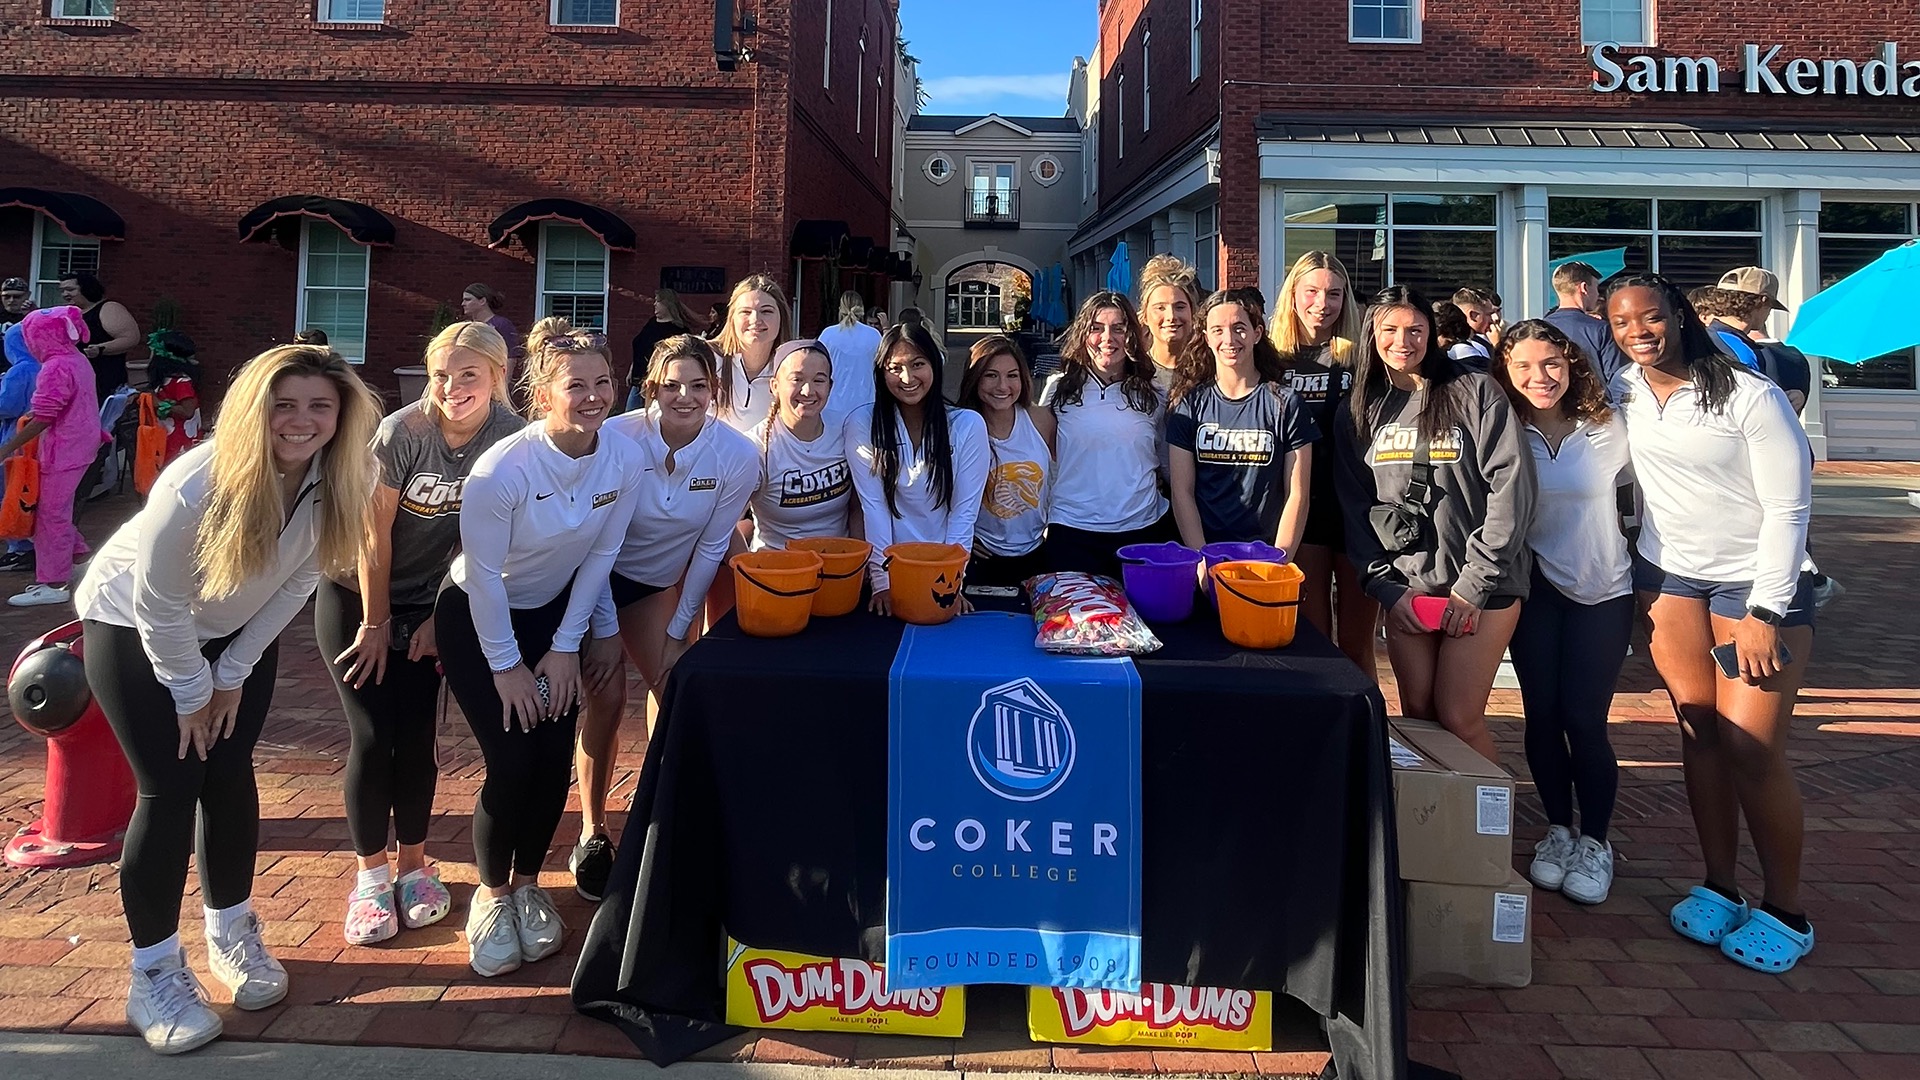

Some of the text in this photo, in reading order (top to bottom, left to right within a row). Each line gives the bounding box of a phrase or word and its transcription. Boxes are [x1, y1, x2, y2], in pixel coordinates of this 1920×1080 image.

[1591, 41, 1720, 93] Sam
[1198, 426, 1272, 452] COKER
[909, 817, 1118, 856] COKER
[952, 864, 1077, 882] COLLEGE
[908, 952, 1116, 973] FOUNDED 1908
